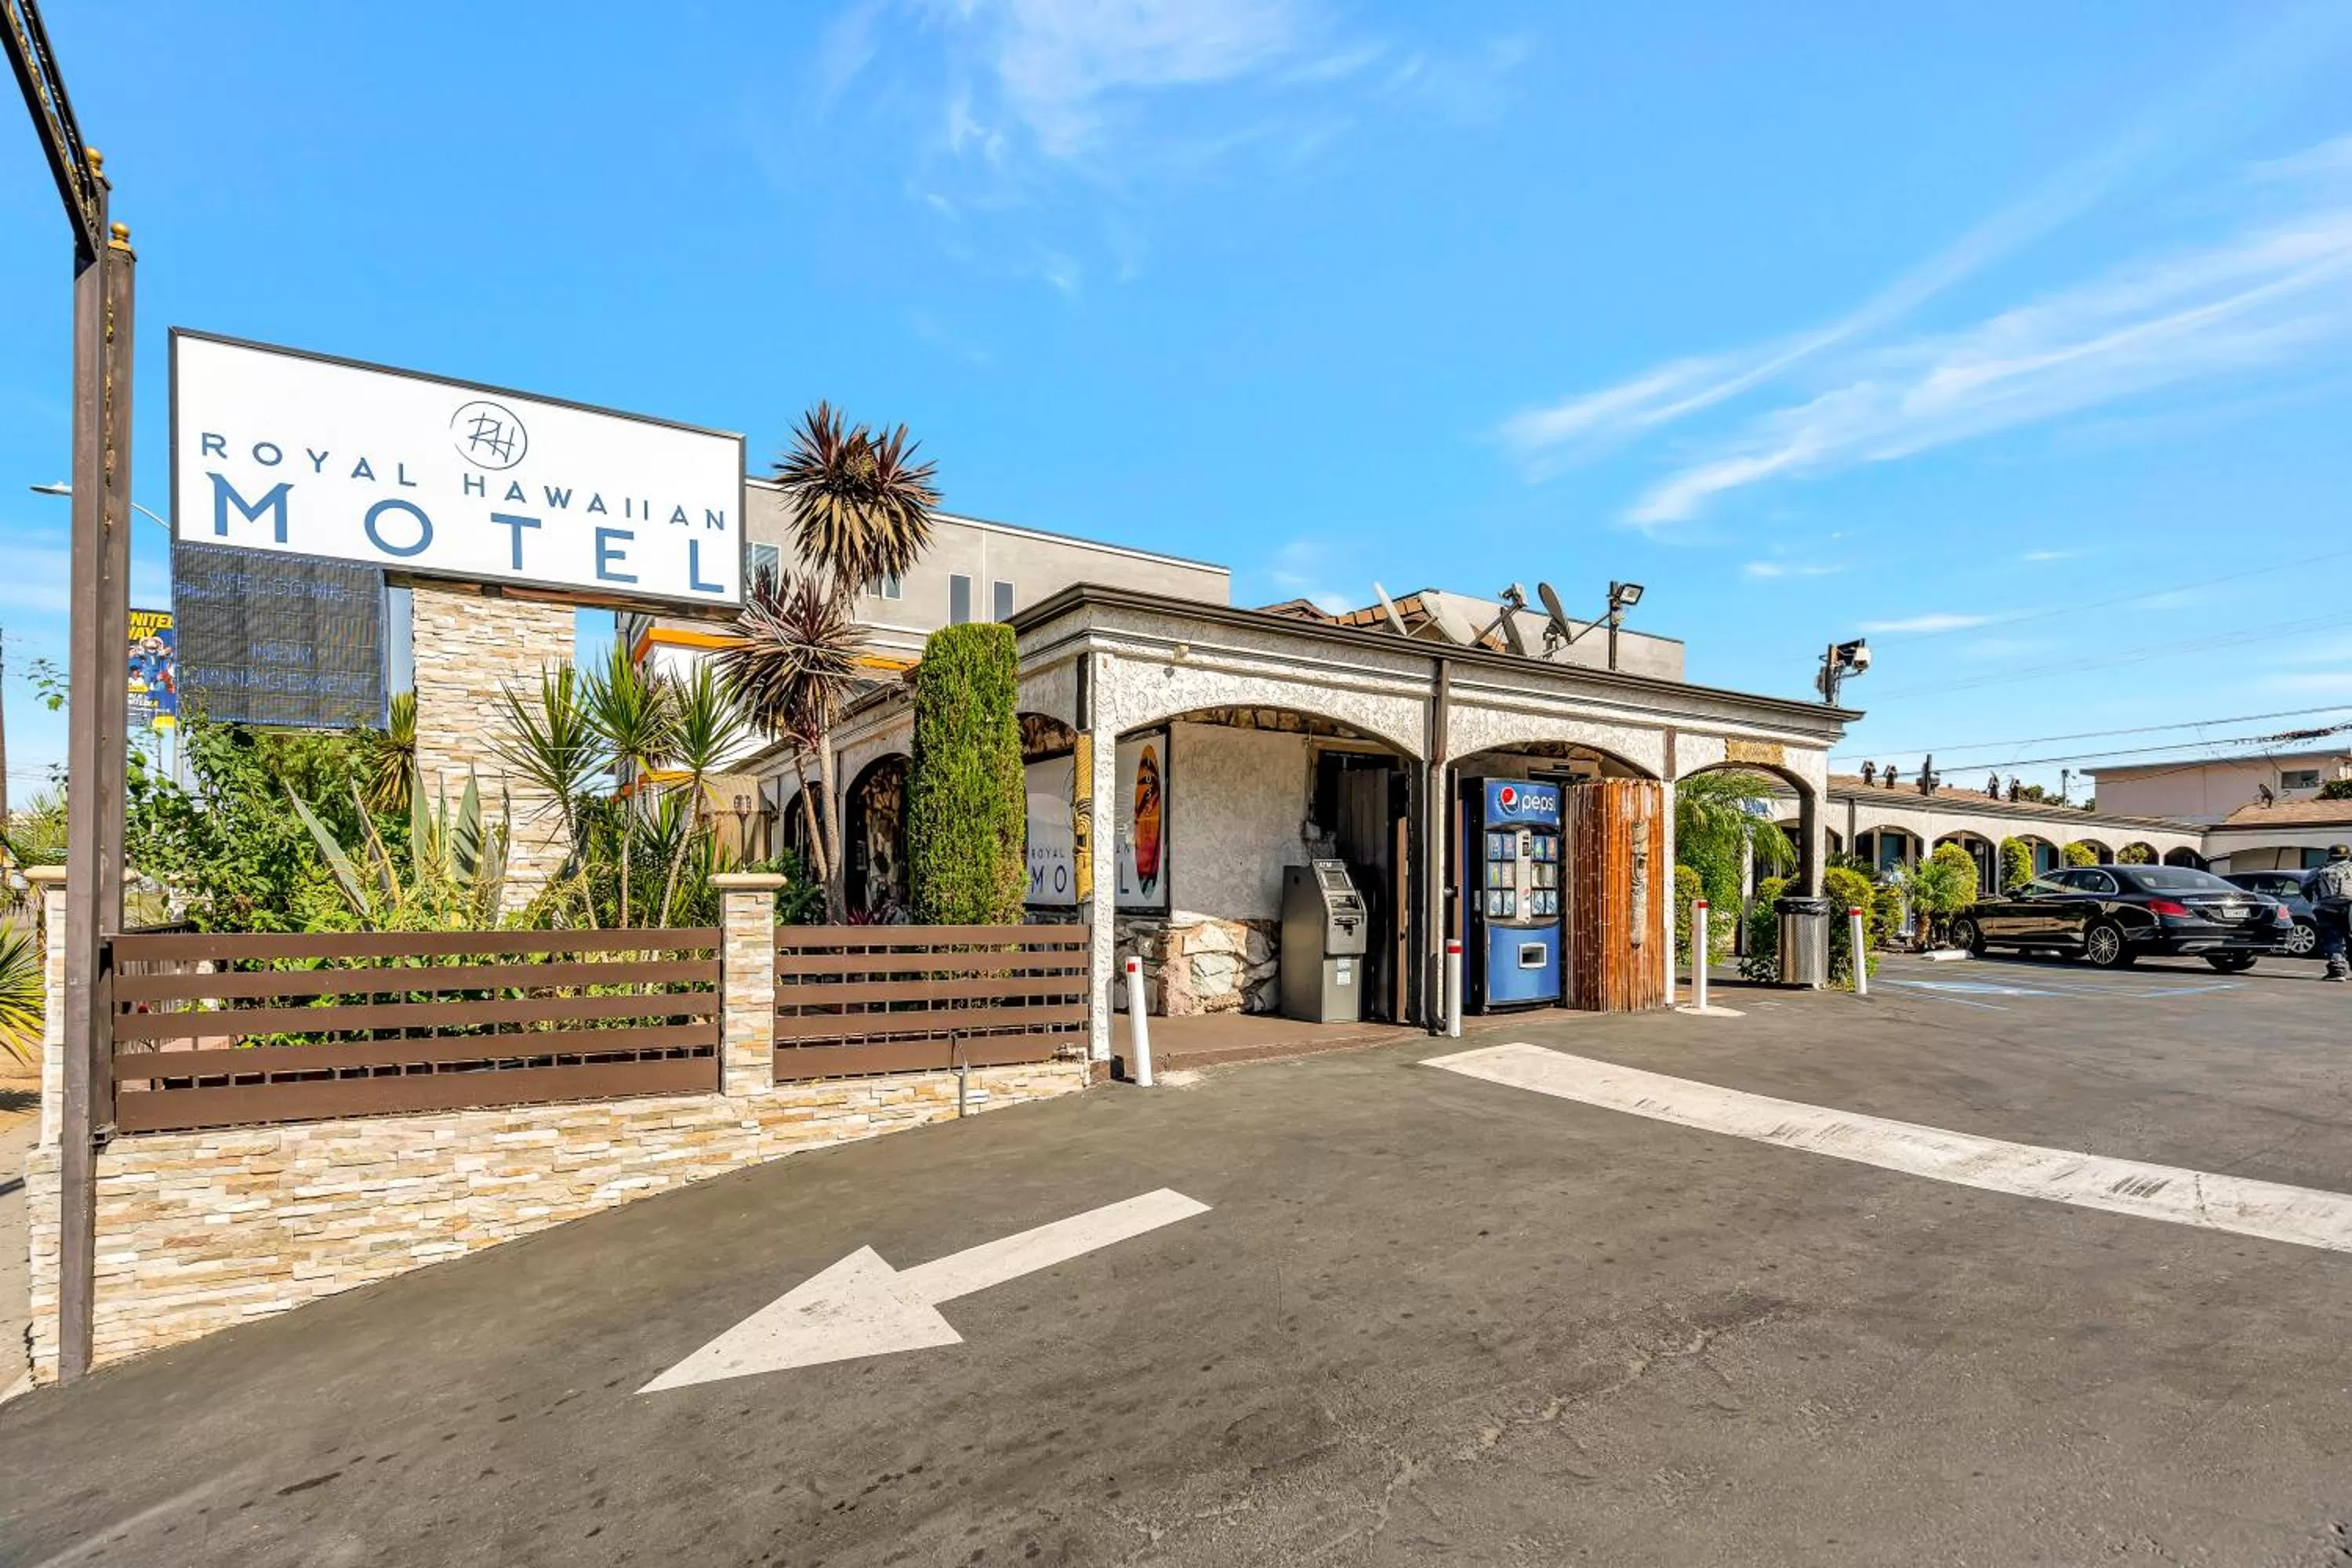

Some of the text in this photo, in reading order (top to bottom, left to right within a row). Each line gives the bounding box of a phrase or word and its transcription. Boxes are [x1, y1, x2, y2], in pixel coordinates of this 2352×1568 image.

[467, 412, 515, 463] RH
[201, 432, 724, 531] ROYAL HAWAIIAN
[205, 471, 724, 593] MOTEL
[129, 612, 173, 629] NITE
